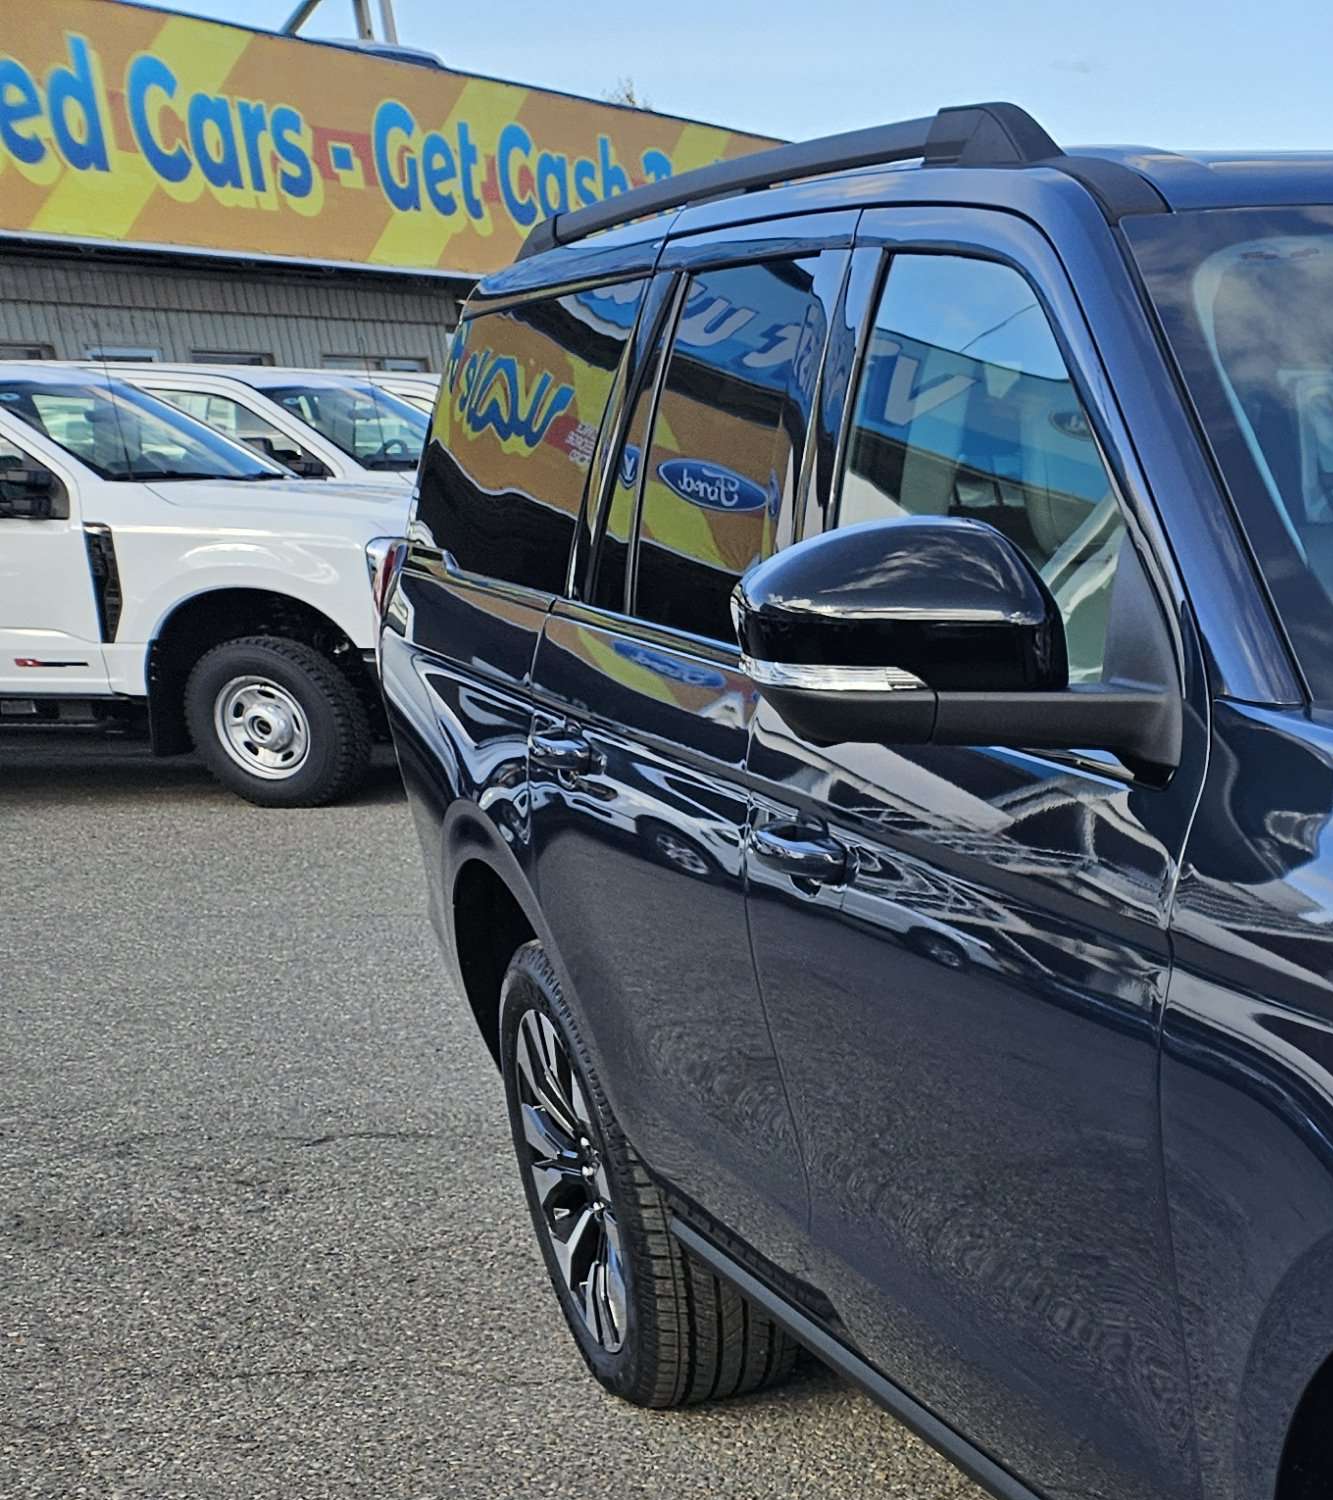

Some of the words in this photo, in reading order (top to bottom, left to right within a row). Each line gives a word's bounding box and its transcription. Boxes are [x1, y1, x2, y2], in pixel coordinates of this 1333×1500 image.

[127, 54, 313, 199] Cars
[373, 101, 484, 221] Get
[498, 122, 631, 227] Cash
